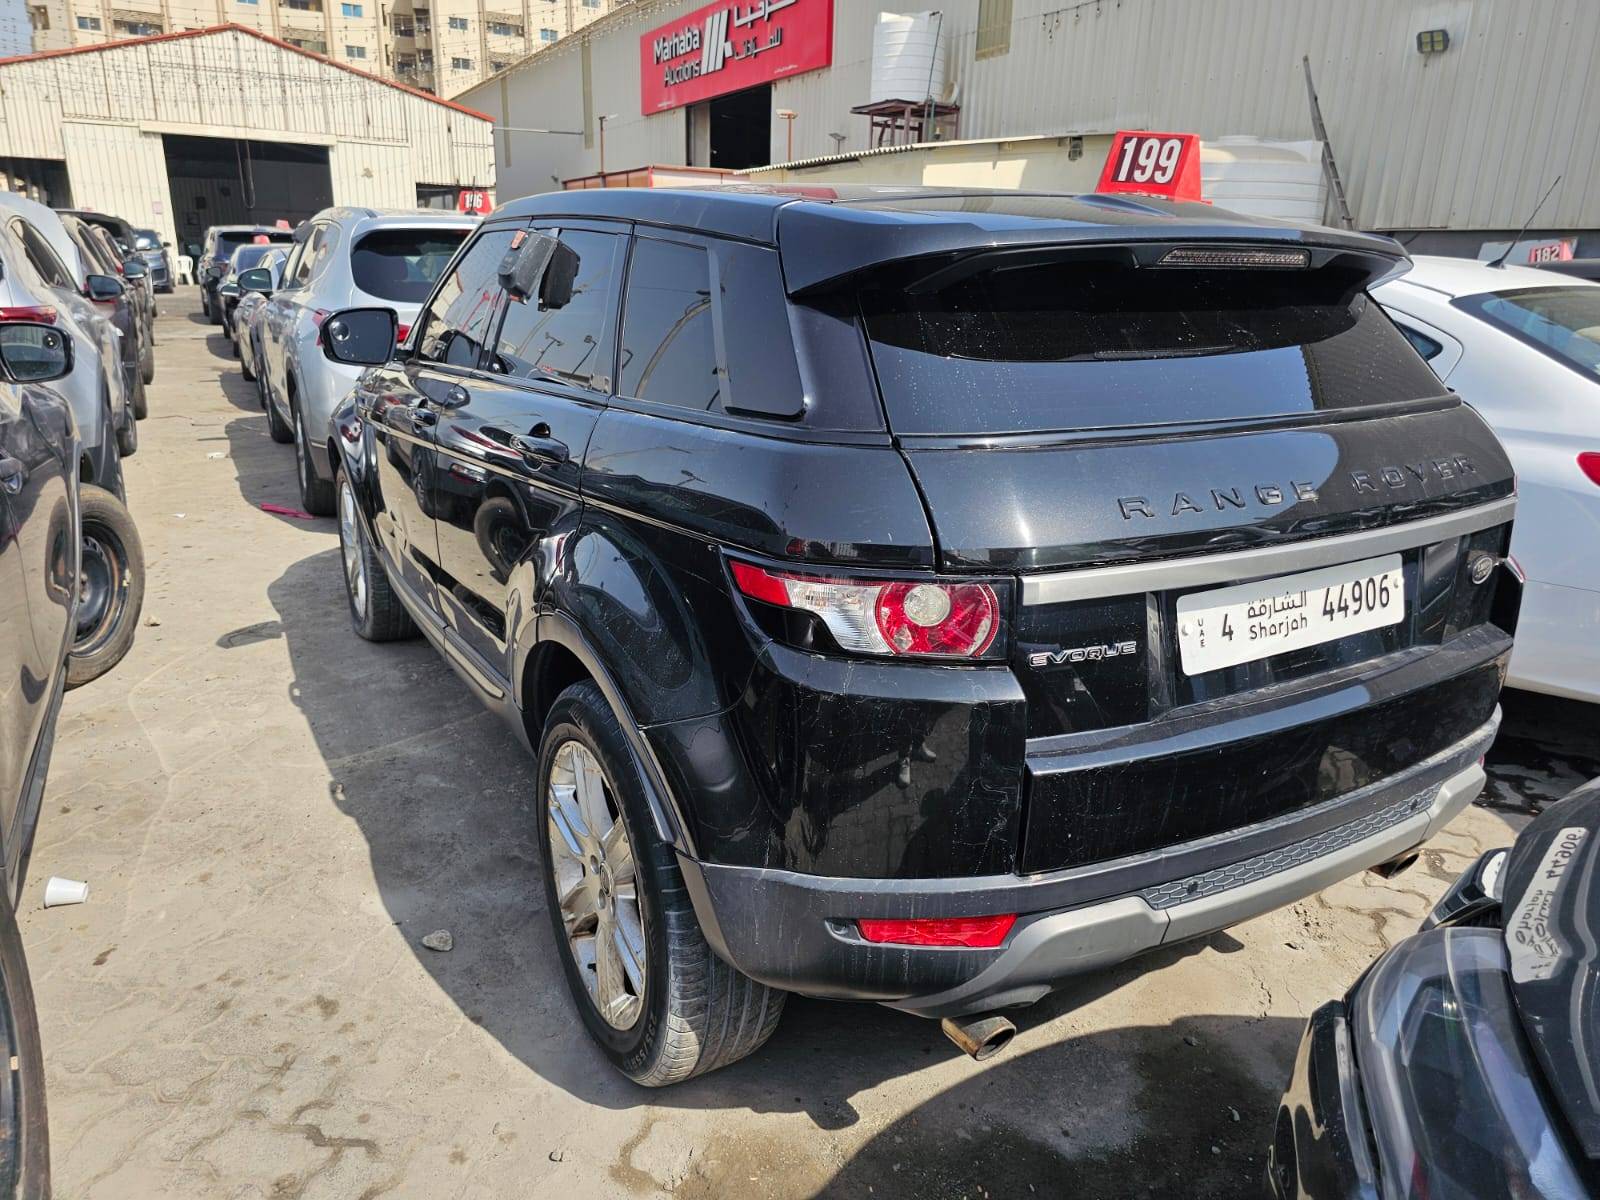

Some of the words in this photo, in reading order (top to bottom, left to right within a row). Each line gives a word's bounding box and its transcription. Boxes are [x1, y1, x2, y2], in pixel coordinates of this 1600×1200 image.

[654, 26, 702, 65] Marhaba
[664, 59, 702, 88] Auctions
[1117, 137, 1182, 184] 199
[1534, 246, 1560, 263] 182
[1117, 480, 1320, 520] RANGE
[1348, 453, 1477, 494] ROVER
[1247, 590, 1307, 619] الشارقة
[1322, 574, 1391, 622] 44906
[1221, 613, 1234, 641] 4
[1249, 613, 1308, 641] Sharjah
[1028, 641, 1137, 667] EVOQUE
